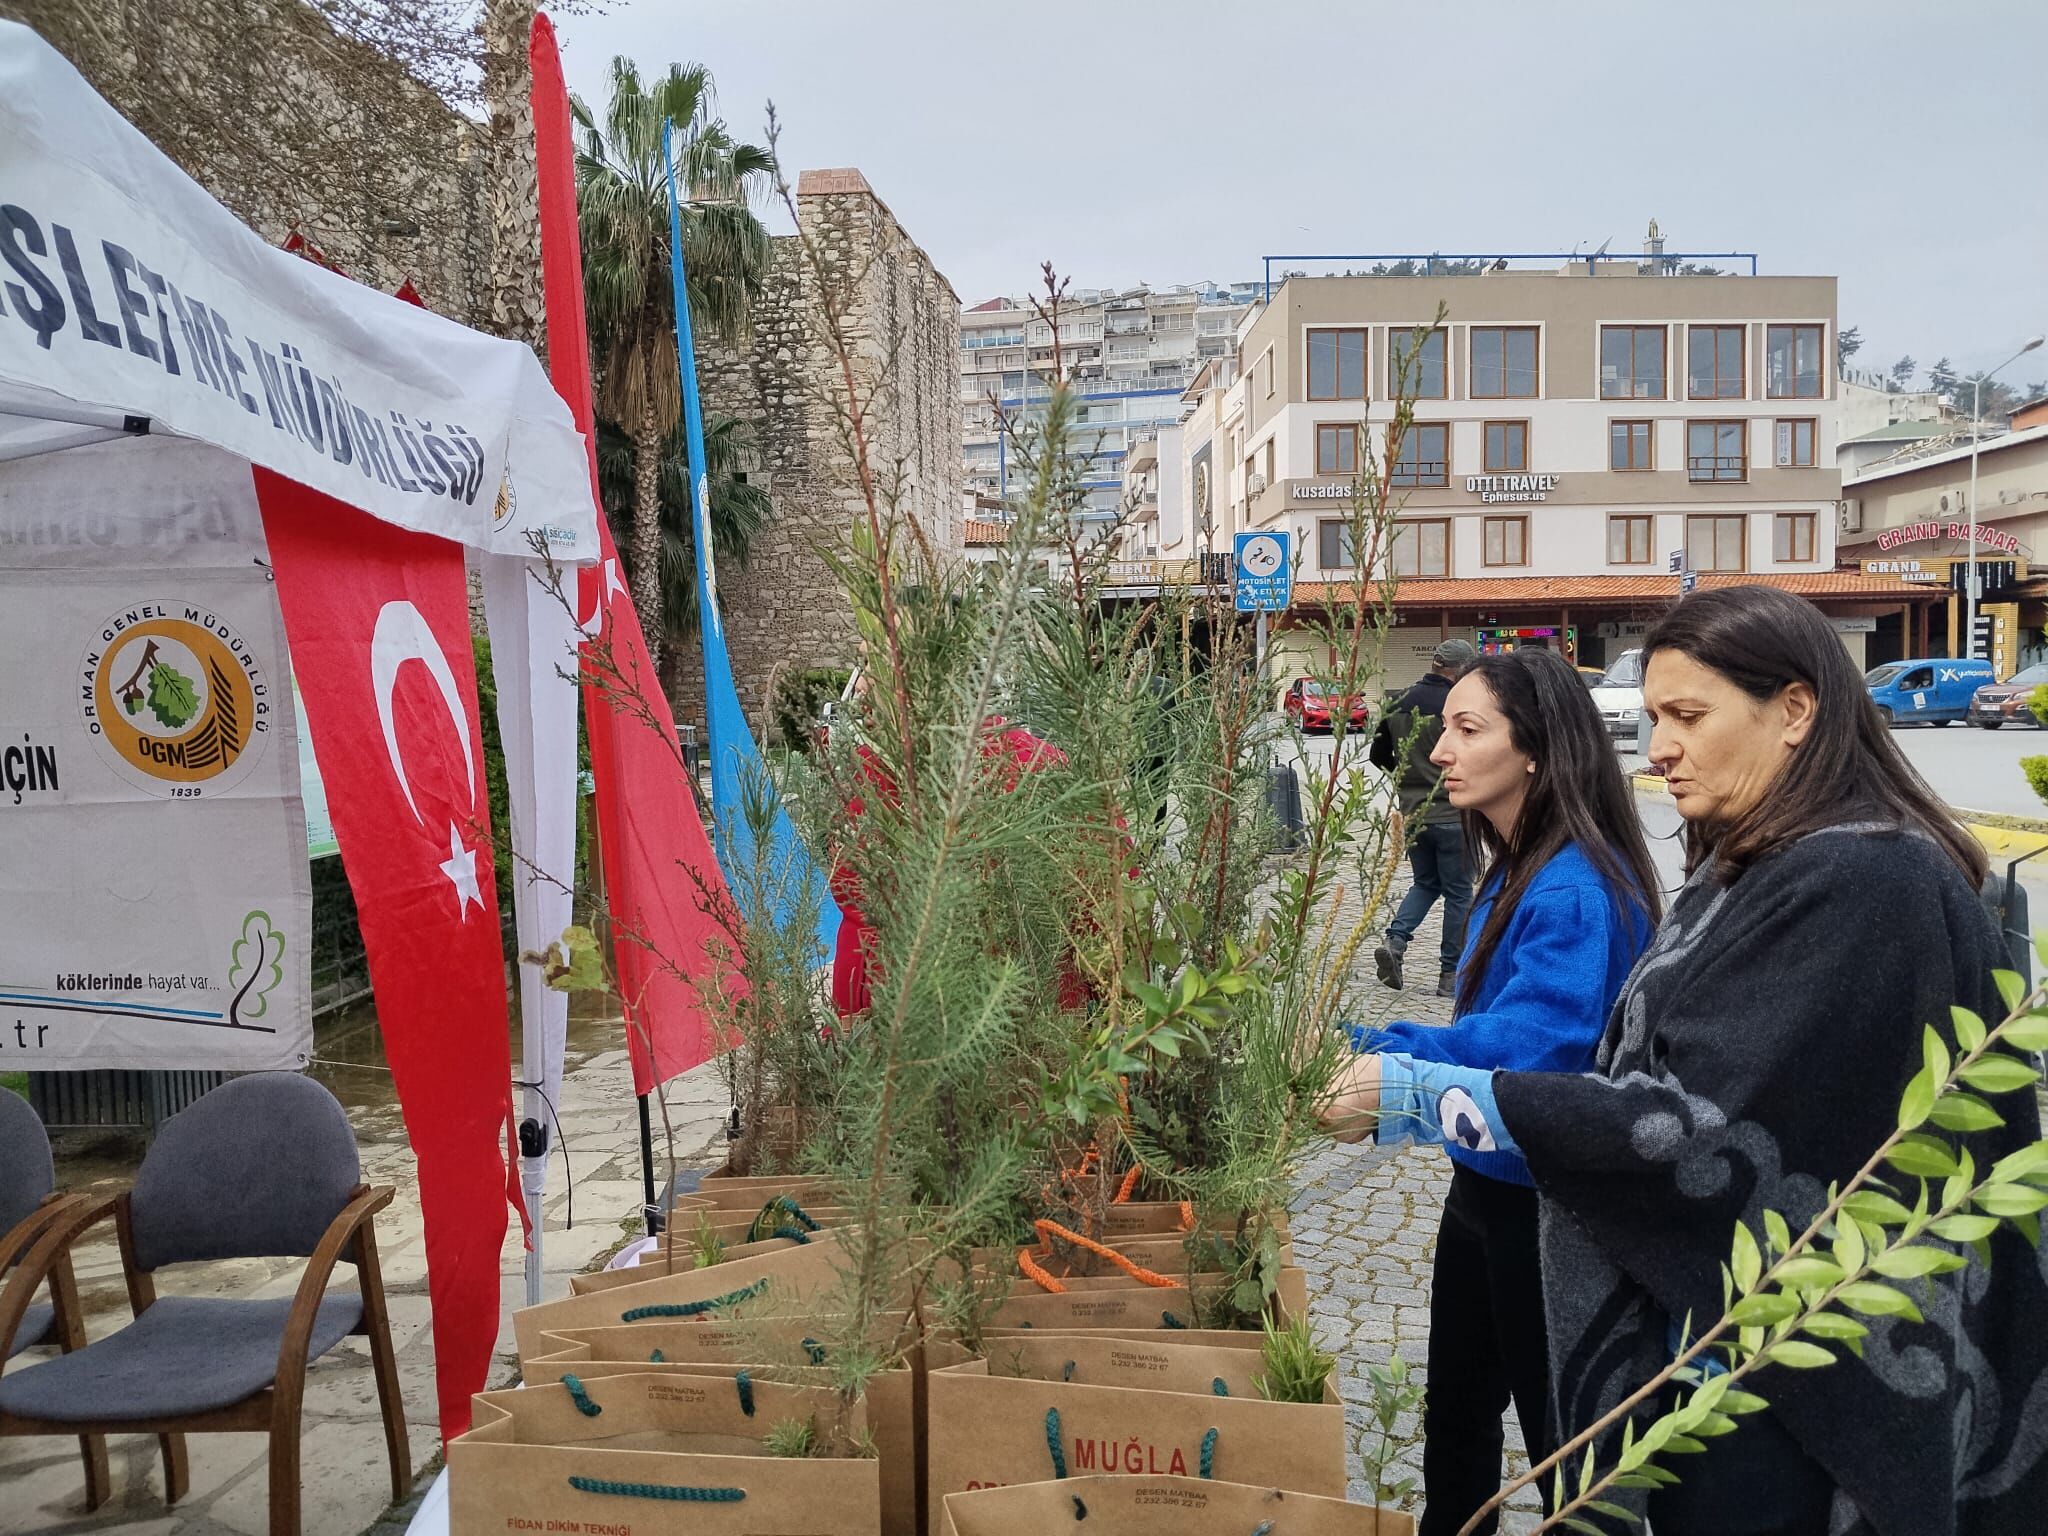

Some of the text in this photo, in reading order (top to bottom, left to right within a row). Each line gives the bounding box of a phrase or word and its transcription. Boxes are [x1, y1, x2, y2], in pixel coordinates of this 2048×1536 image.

[0, 204, 485, 506] ŞLETME MÜDÜRLÜĞÜ
[1466, 475, 1555, 492] OTTI TRAVEL
[1482, 492, 1546, 503] Ephesus.us
[1877, 521, 2019, 553] GRAND BAZAAR
[1866, 561, 1921, 573] GRAND
[82, 605, 270, 735] ORMAN GENEL MÜDÜRLÜĞÜ
[138, 736, 187, 769] OGM
[170, 788, 202, 797] 1839
[56, 973, 220, 992] köklerinde hayat var...
[1111, 1351, 1169, 1364] DESEN MATBAA
[1075, 1436, 1188, 1477] MUĞLA
[1136, 1488, 1208, 1500] DESEN MATBAA
[507, 1517, 632, 1536] FİDAN DİKİM TEKNİĞİ
